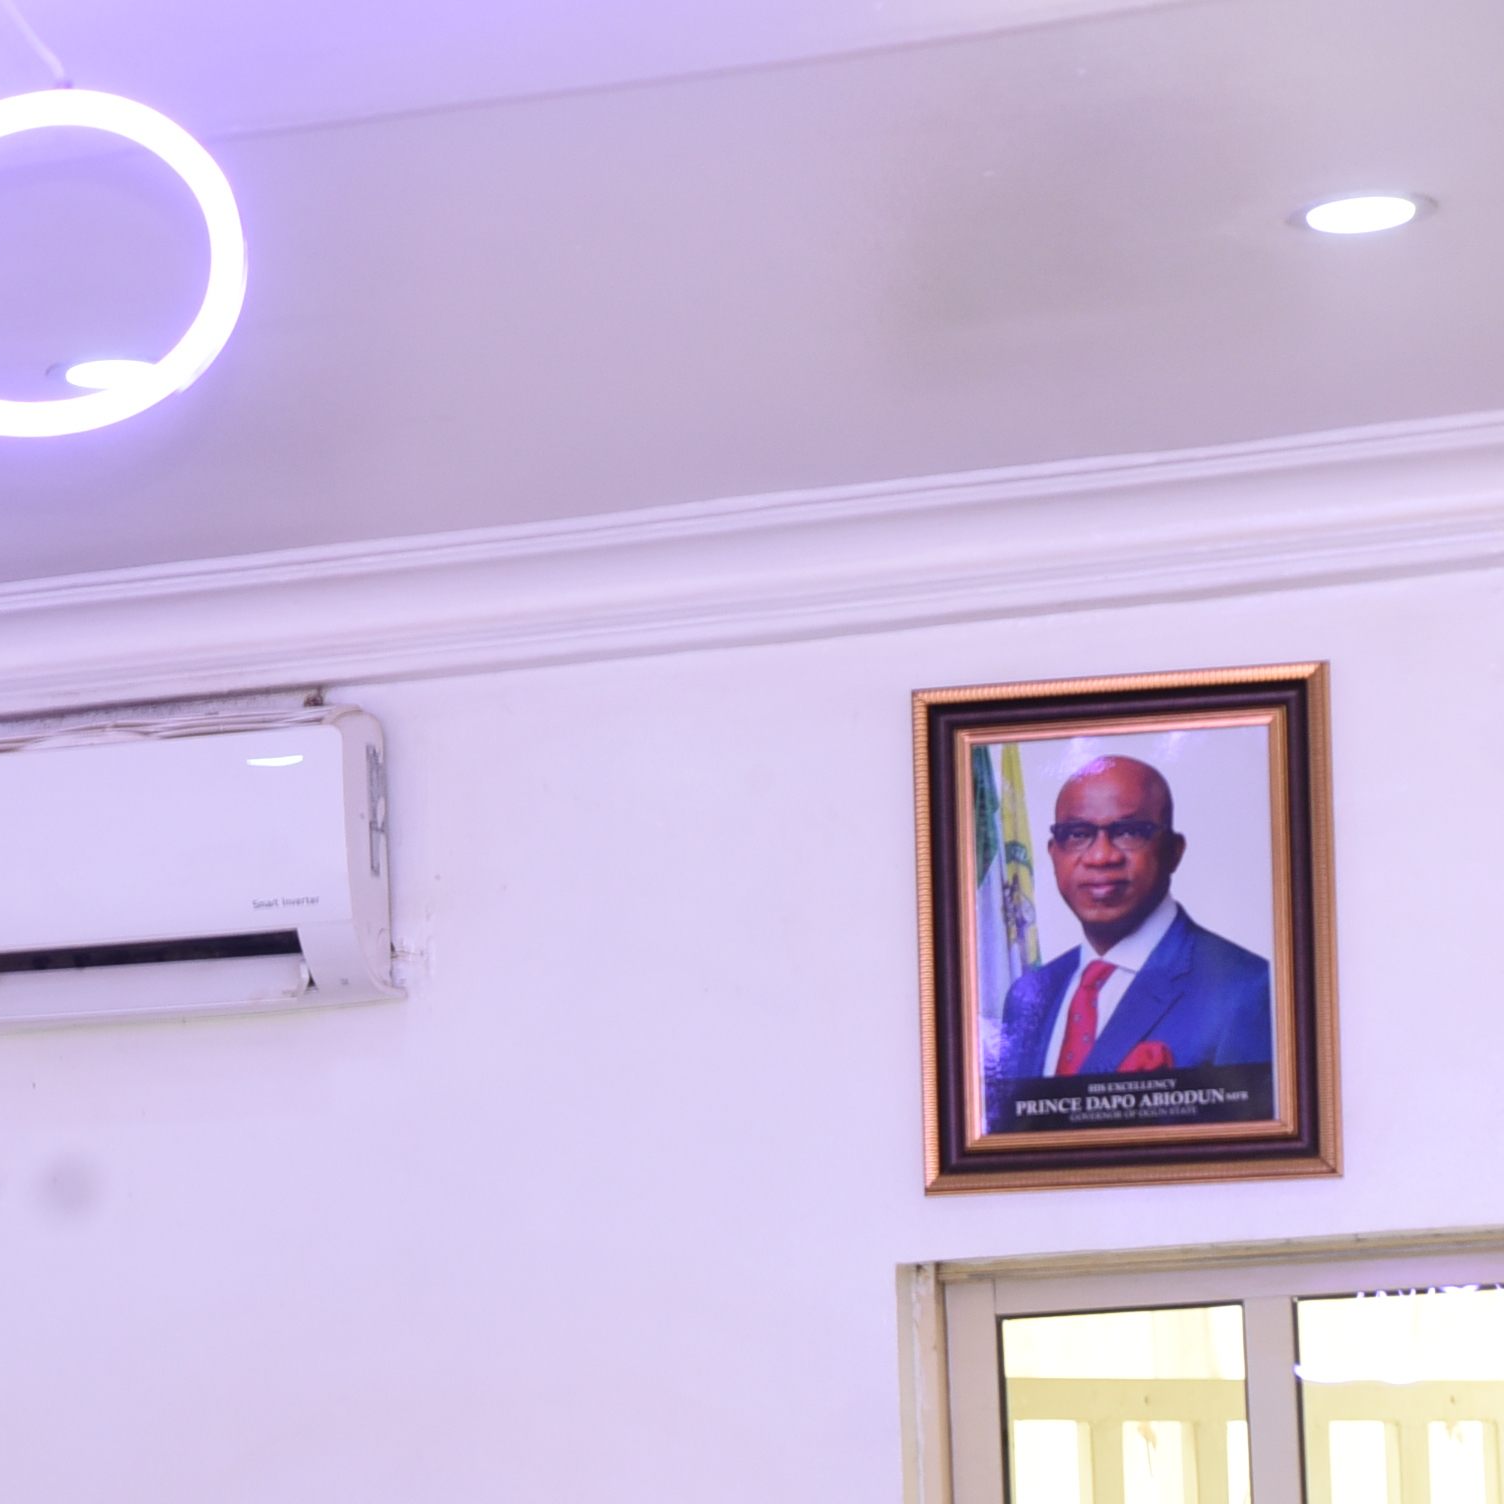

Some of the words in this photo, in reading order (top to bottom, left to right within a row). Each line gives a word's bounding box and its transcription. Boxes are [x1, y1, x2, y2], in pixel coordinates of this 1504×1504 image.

[1108, 1078, 1177, 1092] EXCELLENCY
[1015, 1097, 1083, 1117] PRINCE
[1086, 1093, 1136, 1111] DAPO
[1140, 1087, 1225, 1107] ABIODUN
